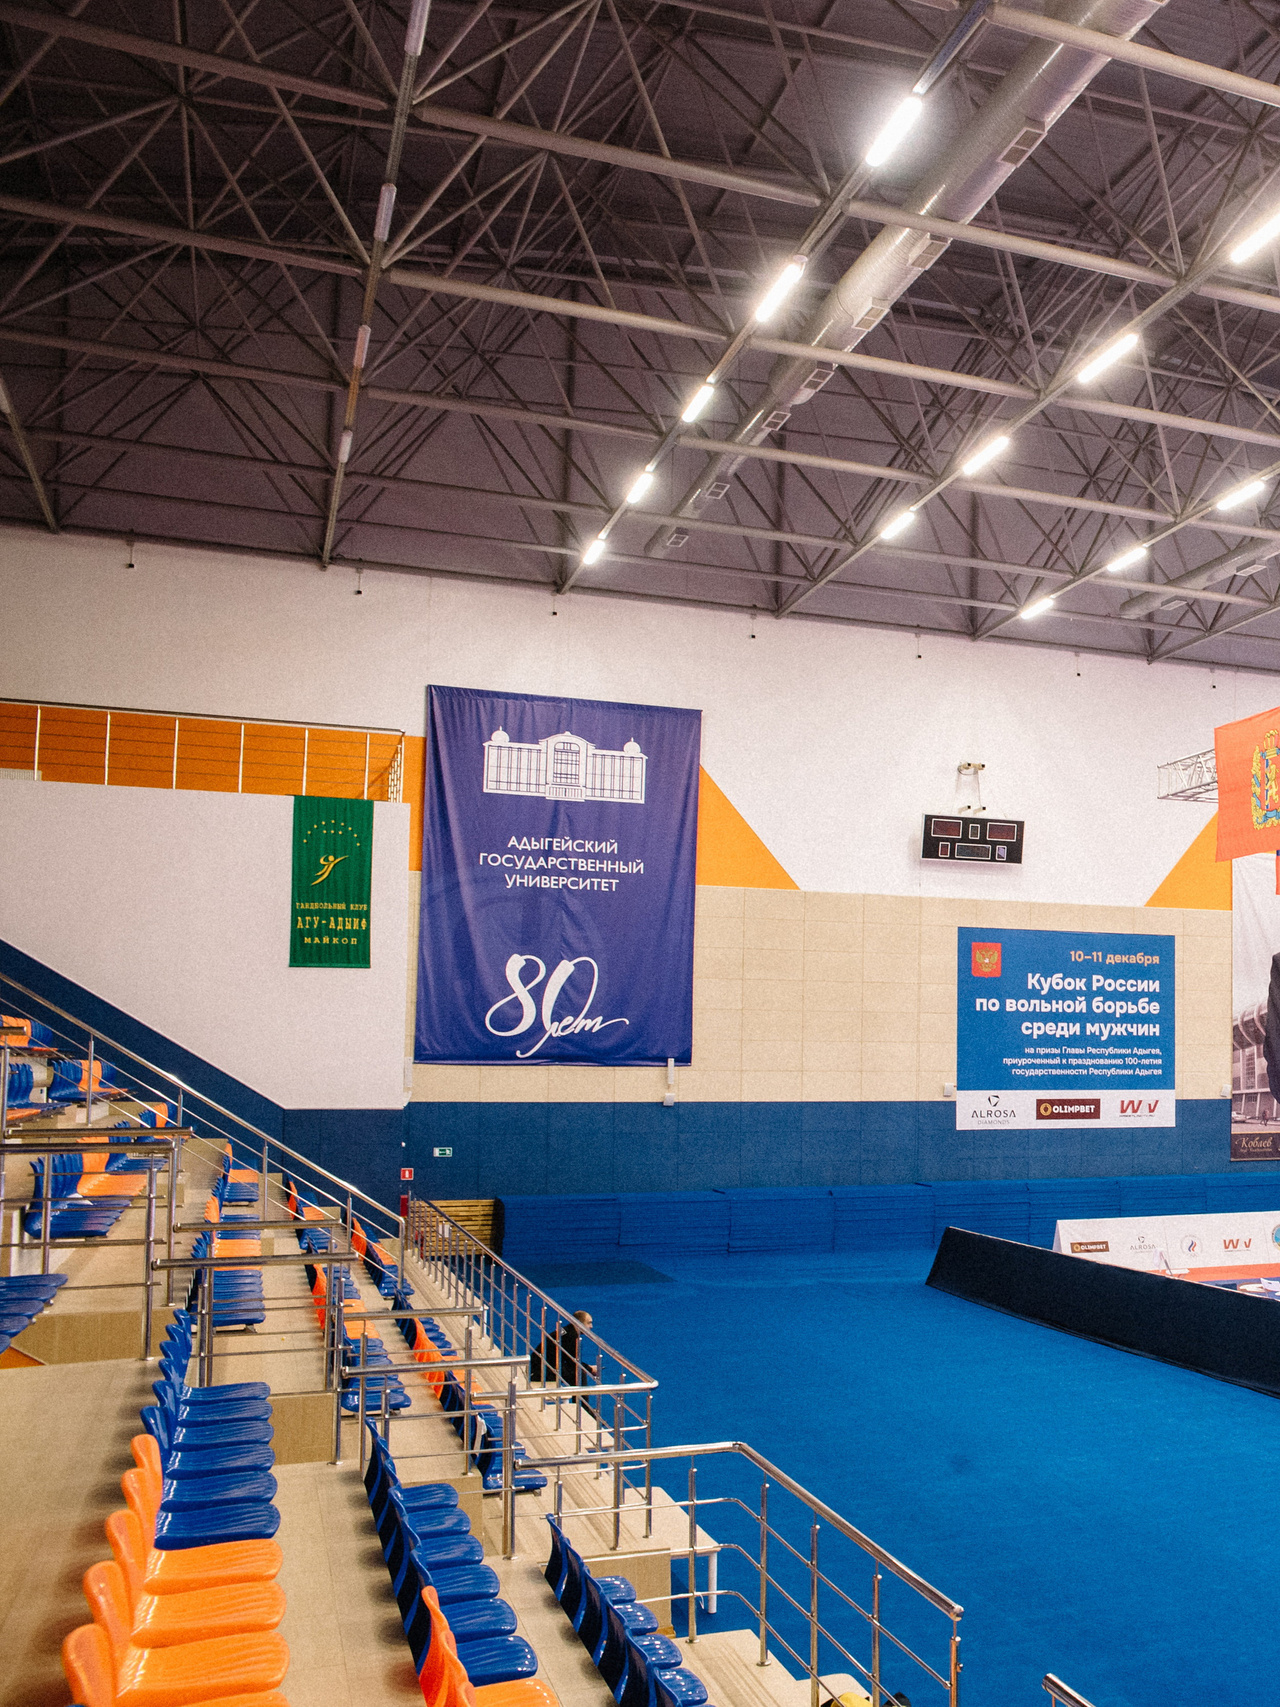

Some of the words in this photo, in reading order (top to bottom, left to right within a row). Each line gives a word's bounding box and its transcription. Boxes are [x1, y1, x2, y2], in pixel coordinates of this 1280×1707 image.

[507, 834, 619, 855] АДЫГЕЙСКИЙ
[479, 852, 644, 875] ГОСУДАРСТВЕННЫЙ
[504, 873, 620, 892] УНИВЕРСИТЕТ
[296, 902, 347, 911] ГАНДБОЛЬНЫЙ
[350, 903, 368, 911] КЛУБ
[304, 936, 358, 945] МАЙКОП
[1106, 952, 1160, 967] декабря
[1027, 973, 1087, 995] Кубок
[1092, 974, 1160, 993] России
[485, 953, 599, 1037] 80
[976, 998, 1000, 1012] по
[1005, 996, 1087, 1014] вольной
[1092, 996, 1160, 1018] борьбе
[1021, 1020, 1081, 1039] среди
[1086, 1022, 1160, 1041] мужчин
[1036, 1047, 1060, 1056] призы
[1062, 1046, 1085, 1055] Главы
[1087, 1047, 1131, 1056] Республики
[1133, 1047, 1162, 1056] Адыгея,
[1003, 1057, 1060, 1066] приуроченный
[1068, 1058, 1123, 1066] празднованию
[1125, 1057, 1162, 1065] 100-летия
[1012, 1068, 1087, 1077] государственности
[1089, 1068, 1133, 1077] Республики
[1135, 1068, 1162, 1077] Адыгея
[971, 1109, 1016, 1118] ALROSA
[1053, 1105, 1095, 1114] OLIMPBET
[1236, 1136, 1273, 1148] Коблев
